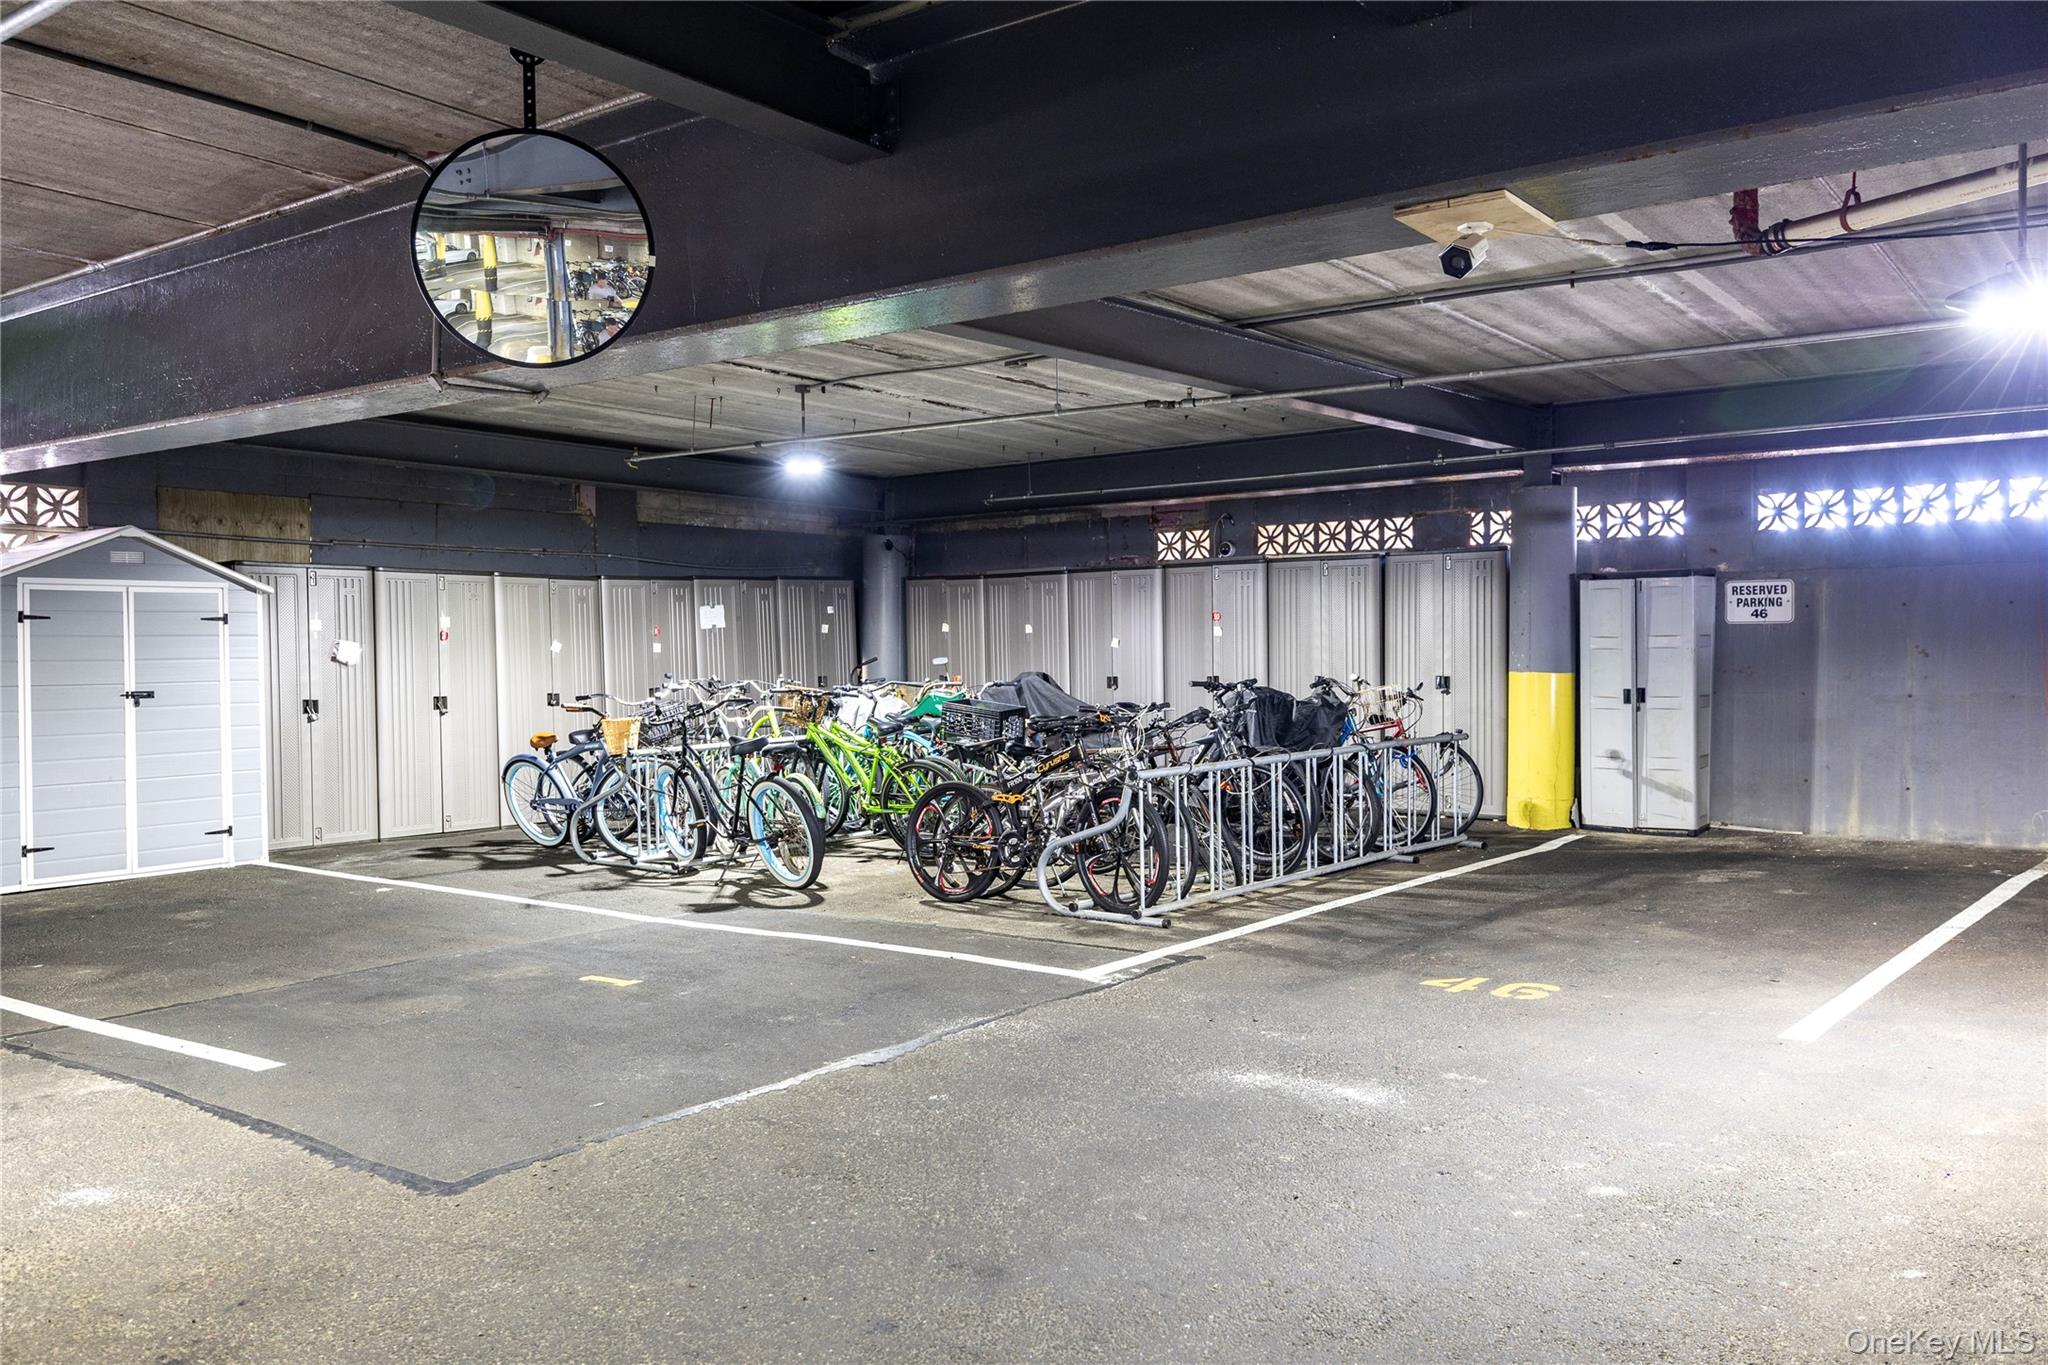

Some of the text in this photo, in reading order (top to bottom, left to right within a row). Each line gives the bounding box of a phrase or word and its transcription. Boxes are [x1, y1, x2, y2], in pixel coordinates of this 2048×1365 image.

[1731, 585, 1787, 596] RESERVED
[1736, 597, 1783, 608] PARKING
[1751, 609, 1768, 618] 46
[1419, 976, 1561, 1000] 46
